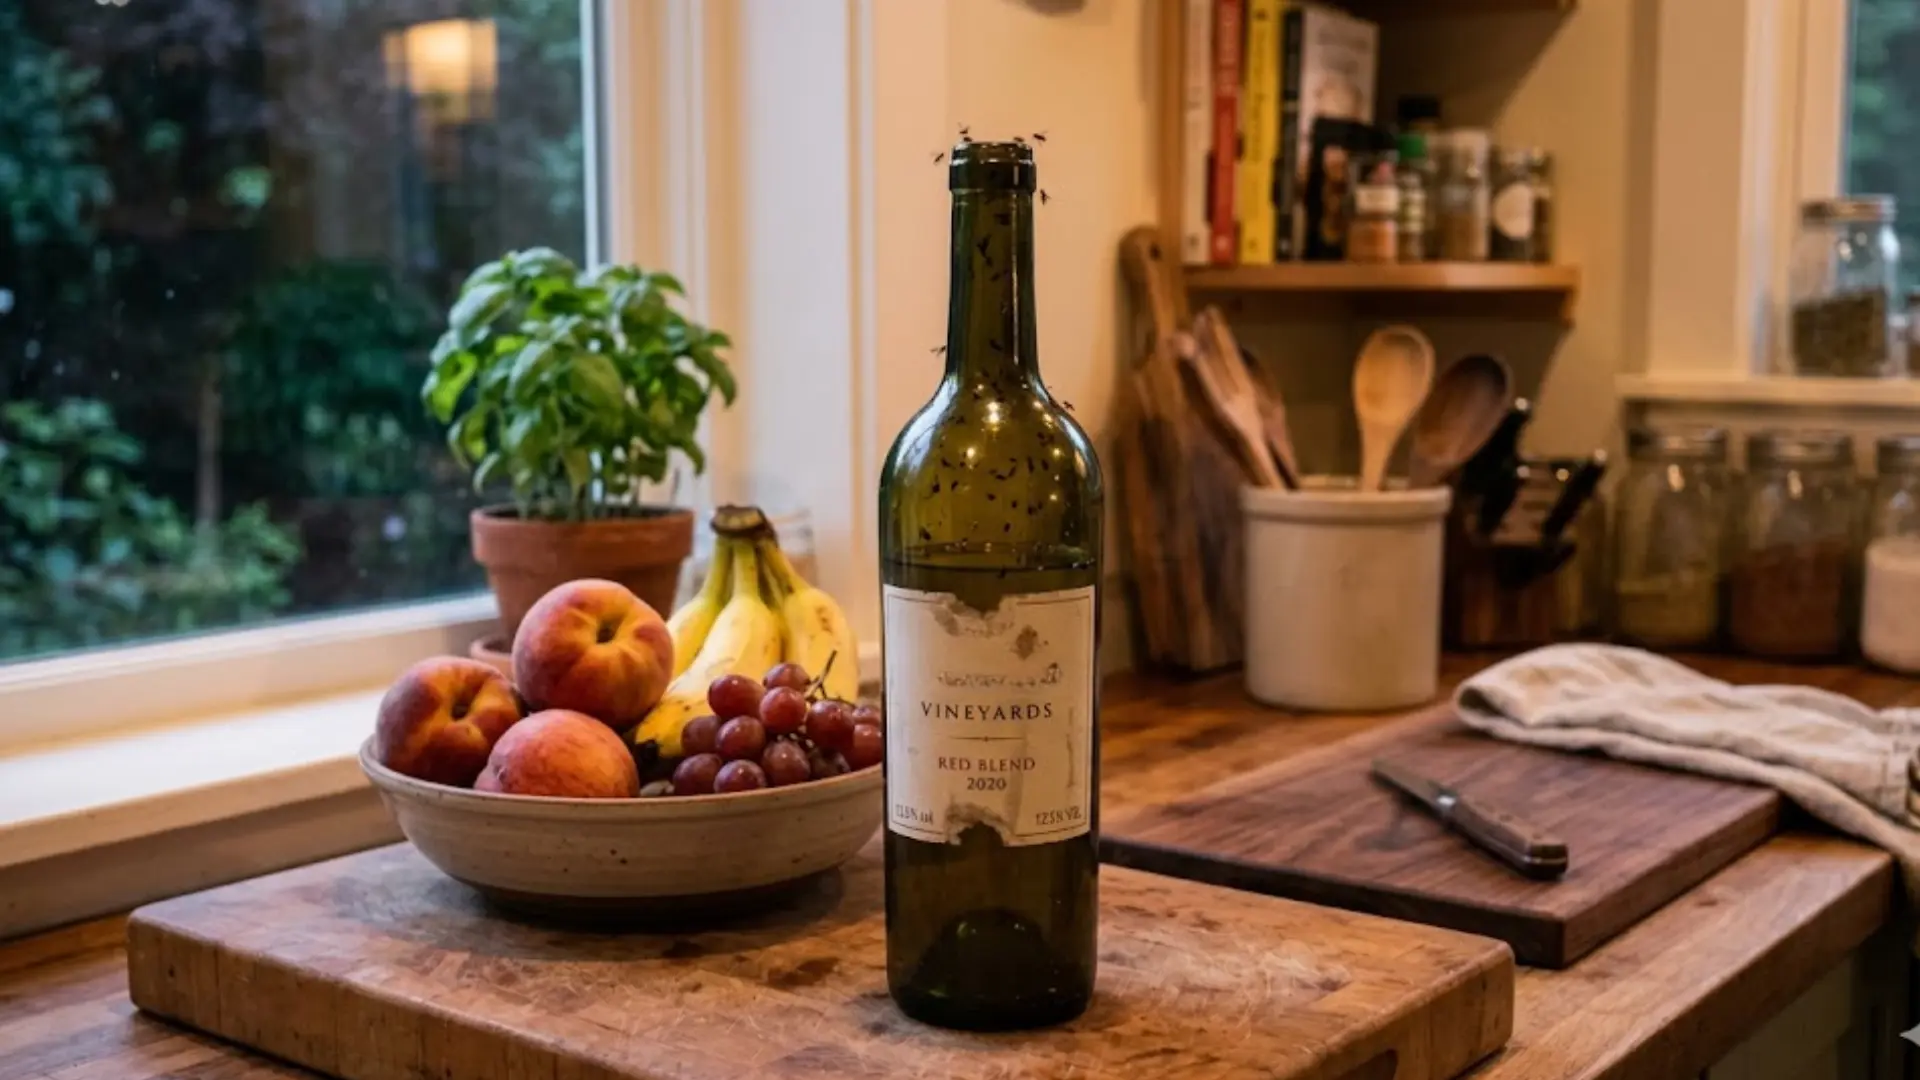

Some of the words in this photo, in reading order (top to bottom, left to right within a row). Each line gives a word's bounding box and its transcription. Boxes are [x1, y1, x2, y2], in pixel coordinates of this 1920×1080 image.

[921, 701, 1053, 721] VINEYARDS
[938, 757, 971, 771] RED
[979, 757, 1036, 772] BLEND
[966, 777, 1007, 791] 2020
